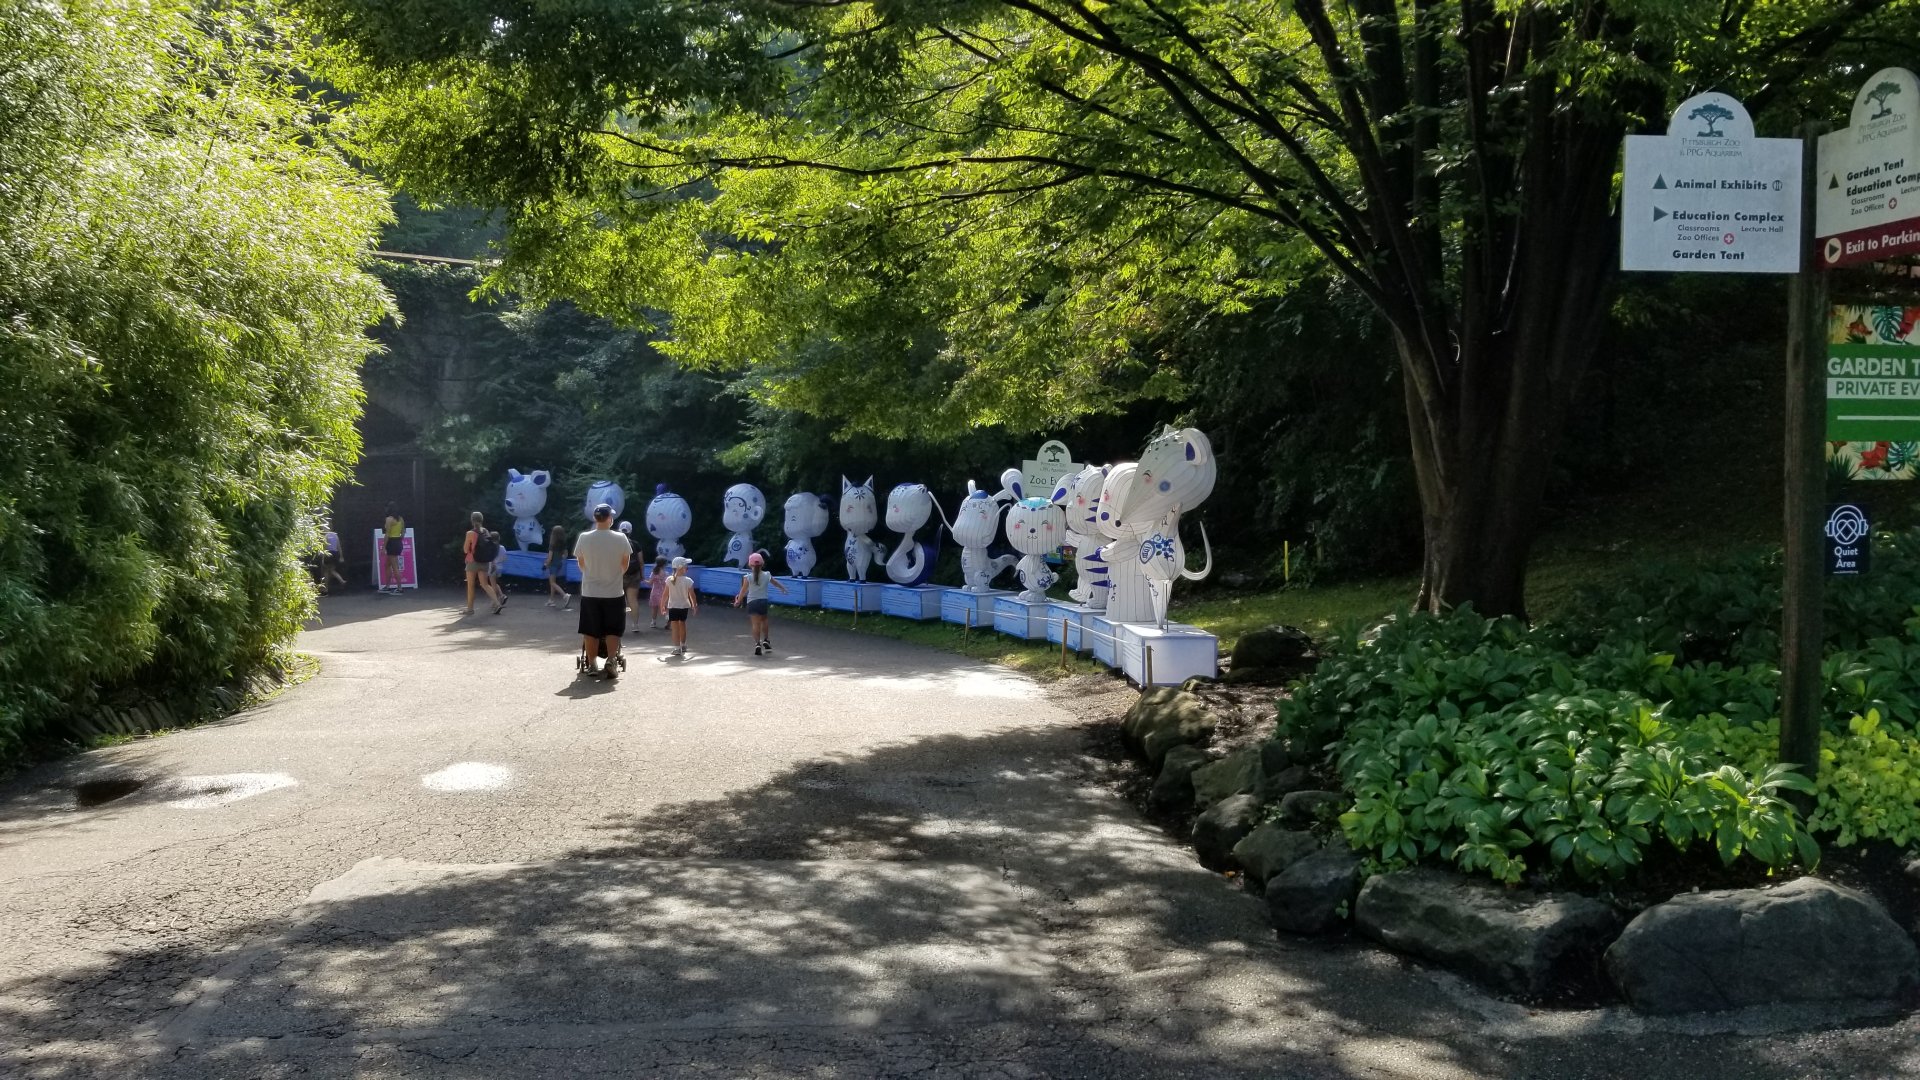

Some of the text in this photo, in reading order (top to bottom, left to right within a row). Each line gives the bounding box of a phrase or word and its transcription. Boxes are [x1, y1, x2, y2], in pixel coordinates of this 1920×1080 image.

[1686, 148, 1703, 157] PPG
[1847, 158, 1904, 182] Garden Tent
[1674, 179, 1768, 191] Animal Exhibits
[1846, 177, 1892, 197] Education
[1851, 193, 1885, 205] Classrooms
[1850, 203, 1885, 215] Zoo Offices
[1672, 211, 1785, 223] Education Complex
[1677, 224, 1720, 232] Classrooms
[1846, 239, 1865, 255] Exit
[1867, 237, 1879, 250] to
[1672, 249, 1745, 260] Garden Tent
[1827, 357, 1906, 376] GARDEN
[1835, 381, 1897, 395] PRIVATE
[1030, 475, 1047, 485] Zoo
[1834, 546, 1859, 558] Quiet
[1835, 558, 1856, 568] Area
